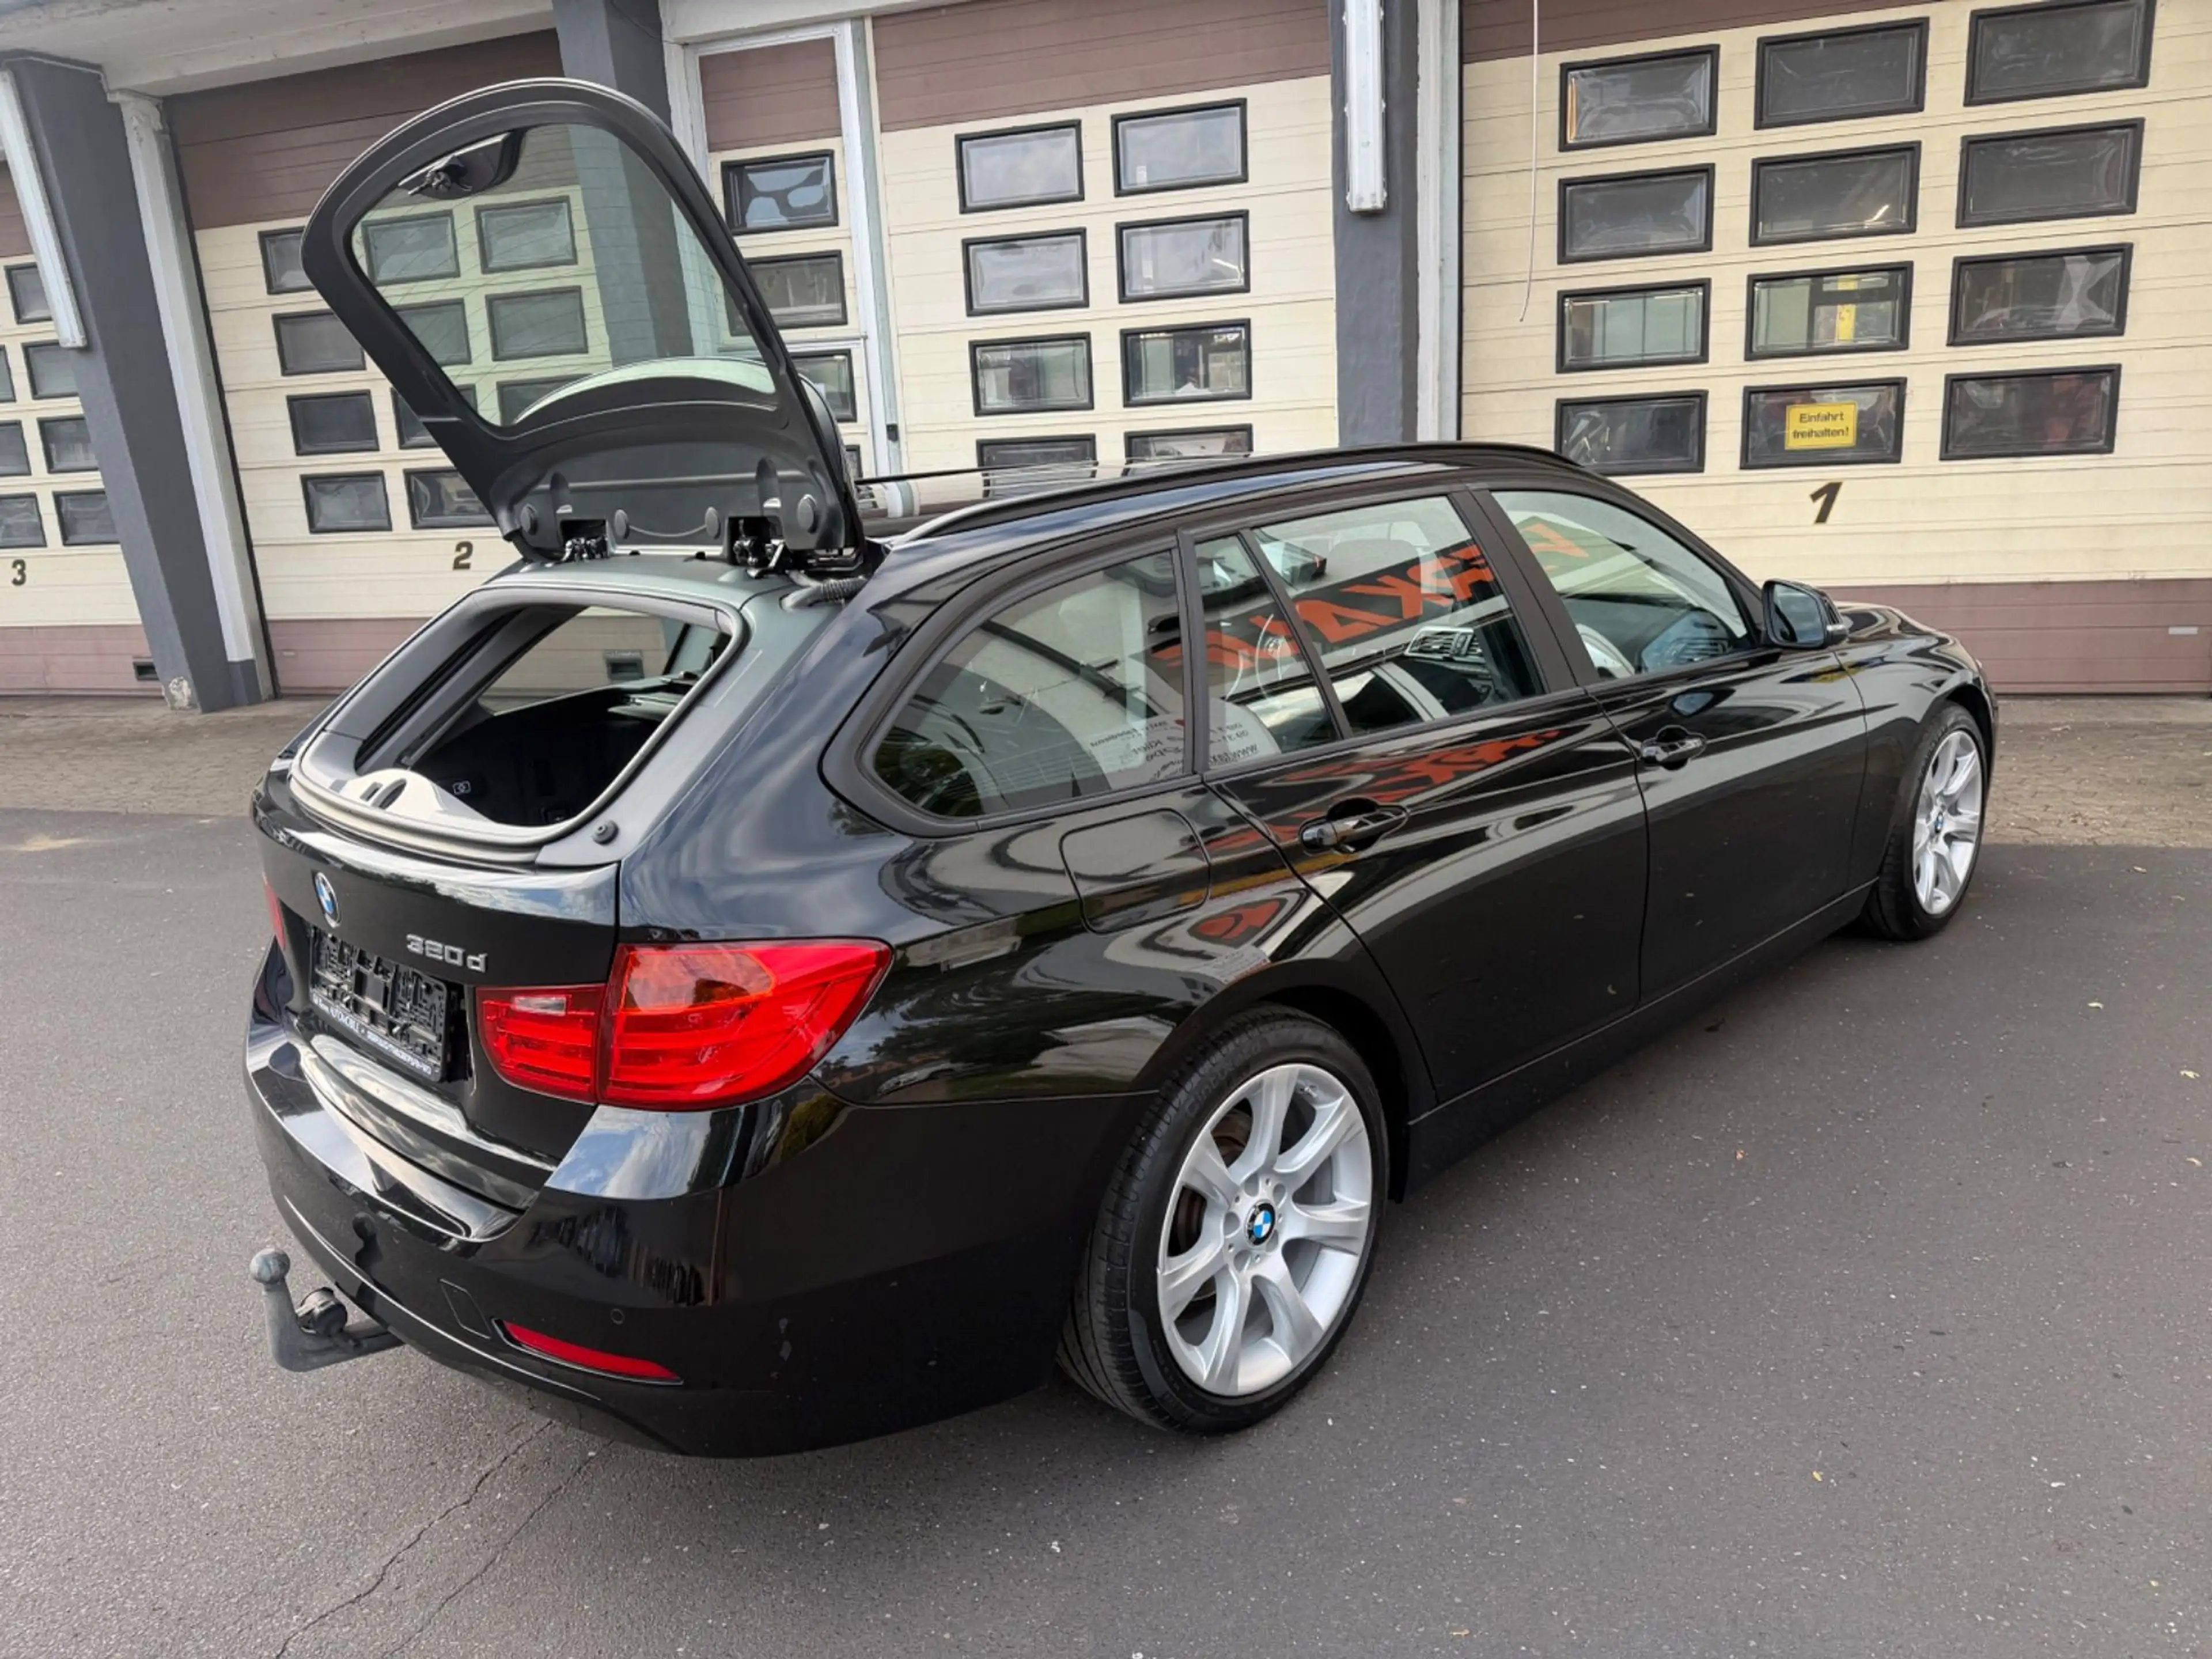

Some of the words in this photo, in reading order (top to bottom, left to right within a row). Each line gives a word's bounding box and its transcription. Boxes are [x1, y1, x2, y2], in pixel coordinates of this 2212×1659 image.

[1799, 411, 1844, 423] Einfahrt
[1793, 427, 1849, 438] freihalten!
[1809, 482, 1843, 524] 1
[453, 541, 473, 570] 2
[12, 559, 26, 586] 3
[406, 933, 488, 973] 320d
